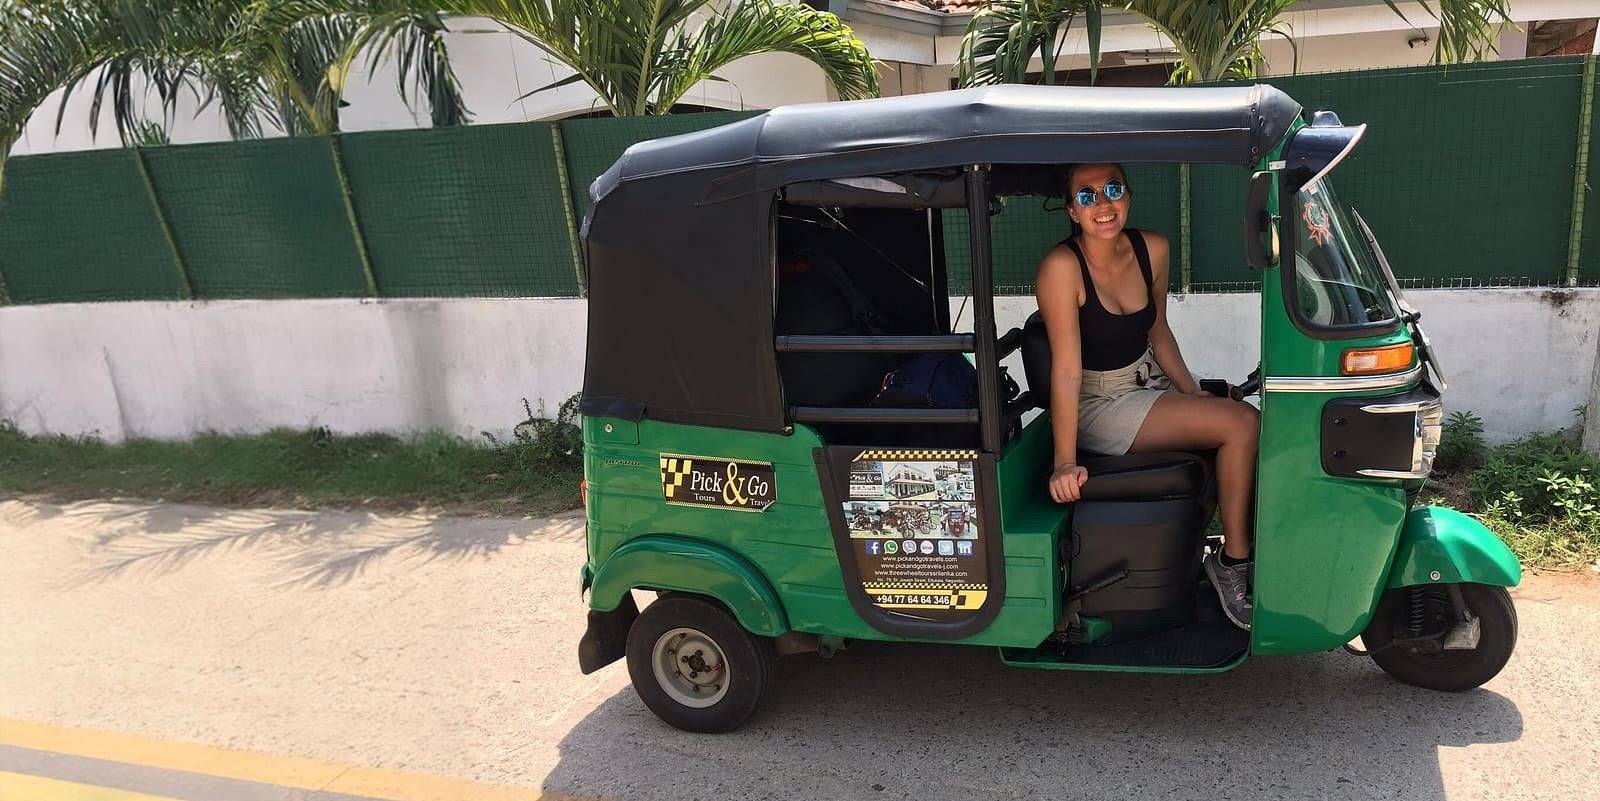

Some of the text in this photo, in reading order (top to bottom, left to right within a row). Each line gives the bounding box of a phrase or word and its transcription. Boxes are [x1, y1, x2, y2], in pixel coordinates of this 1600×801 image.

[690, 462, 769, 505] Pick & Go
[694, 493, 716, 502] Tours
[877, 594, 950, 605] +94 77 64 64 346
